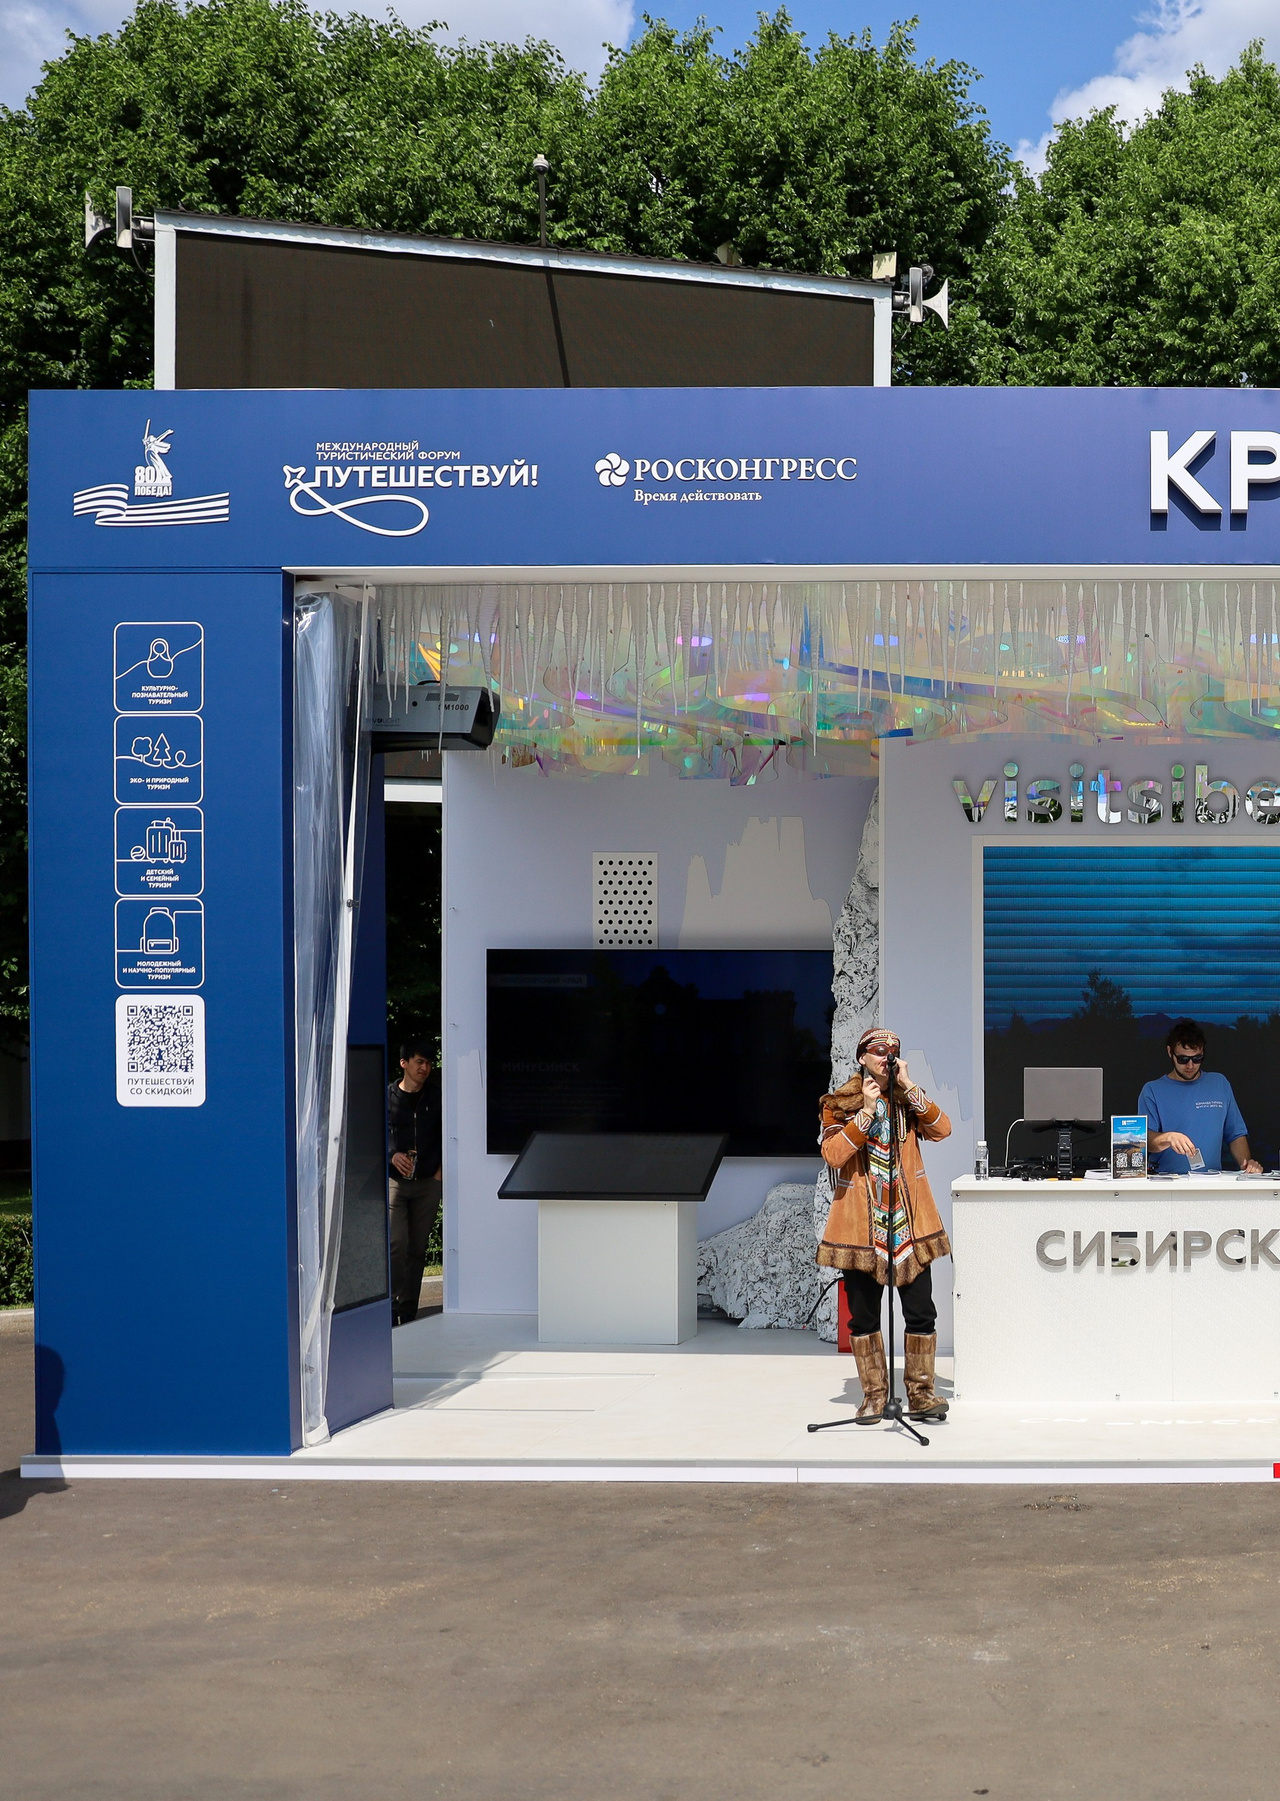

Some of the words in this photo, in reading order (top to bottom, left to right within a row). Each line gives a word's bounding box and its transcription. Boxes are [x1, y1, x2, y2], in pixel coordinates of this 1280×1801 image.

[316, 440, 419, 451] МЕЖДУНАРОДНЫЙ
[316, 450, 414, 461] ТУРИСТИЧЕСКИЙ
[418, 451, 461, 461] ФОРУМ
[314, 459, 538, 487] ПУТЕШЕСТВУЙ!
[633, 457, 858, 481] РОСКОНГРЕСС
[134, 486, 173, 497] ПОБЕДА!
[634, 489, 677, 505] Время
[680, 489, 762, 503] действовать
[127, 1076, 195, 1086] ПУТЕШЕСТВУЙ
[130, 1087, 143, 1095] СО
[145, 1086, 192, 1096] СКИДКОЙ!
